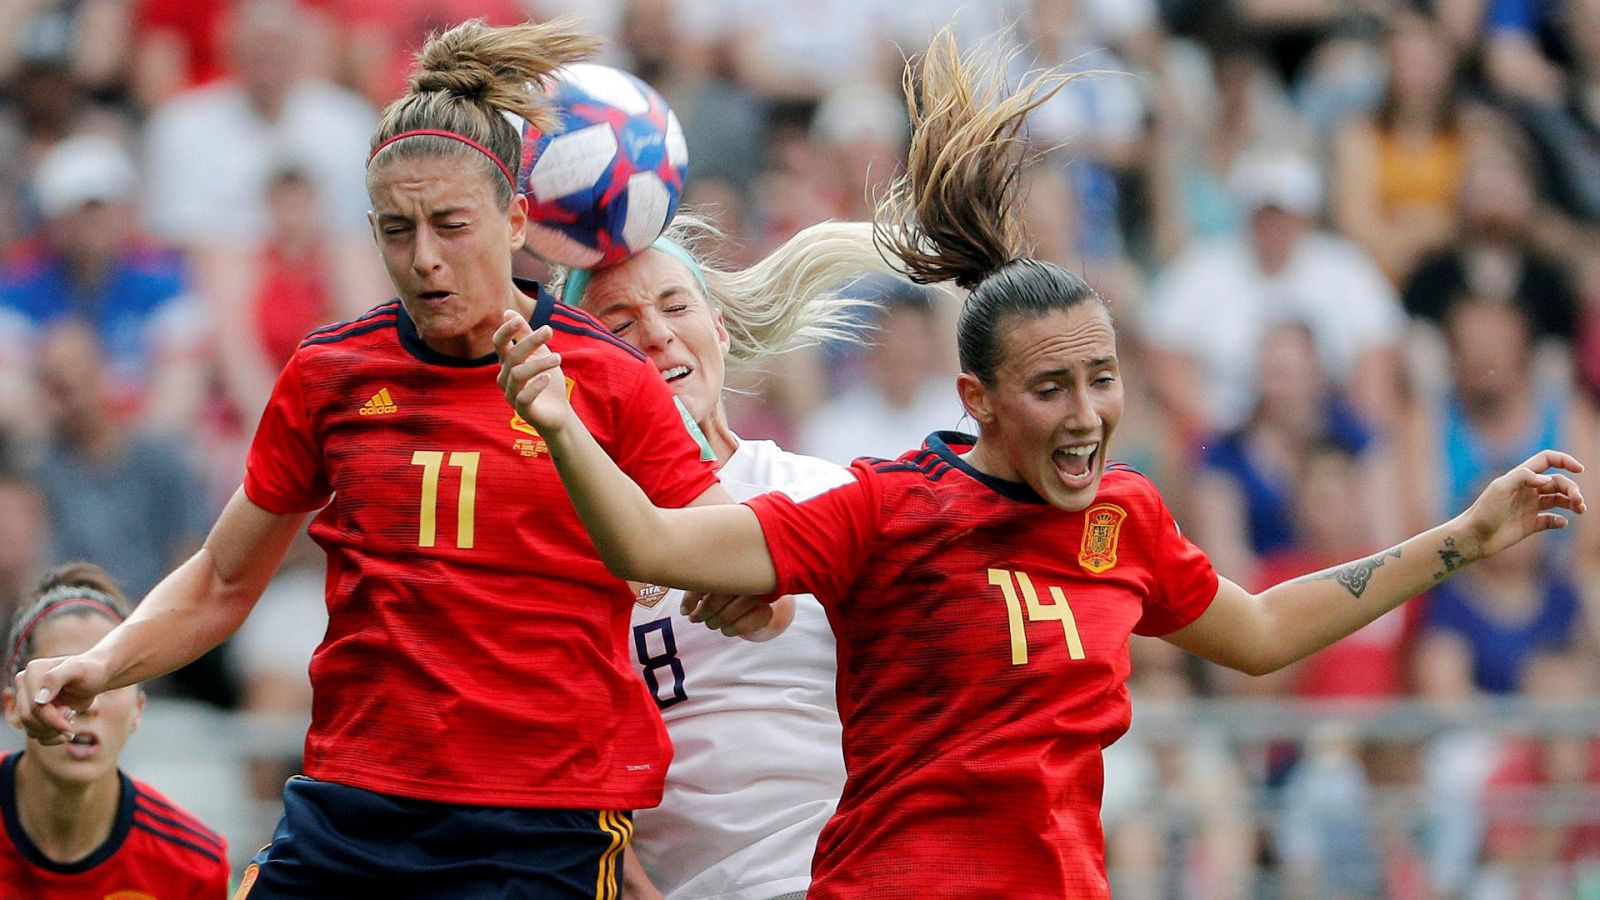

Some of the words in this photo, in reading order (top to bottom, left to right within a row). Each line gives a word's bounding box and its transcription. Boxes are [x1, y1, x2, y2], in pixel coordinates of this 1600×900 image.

[359, 404, 398, 415] adidas
[411, 450, 481, 548] 11
[640, 586, 661, 597] FIFA
[987, 568, 1086, 665] 14
[633, 616, 688, 710] 8
